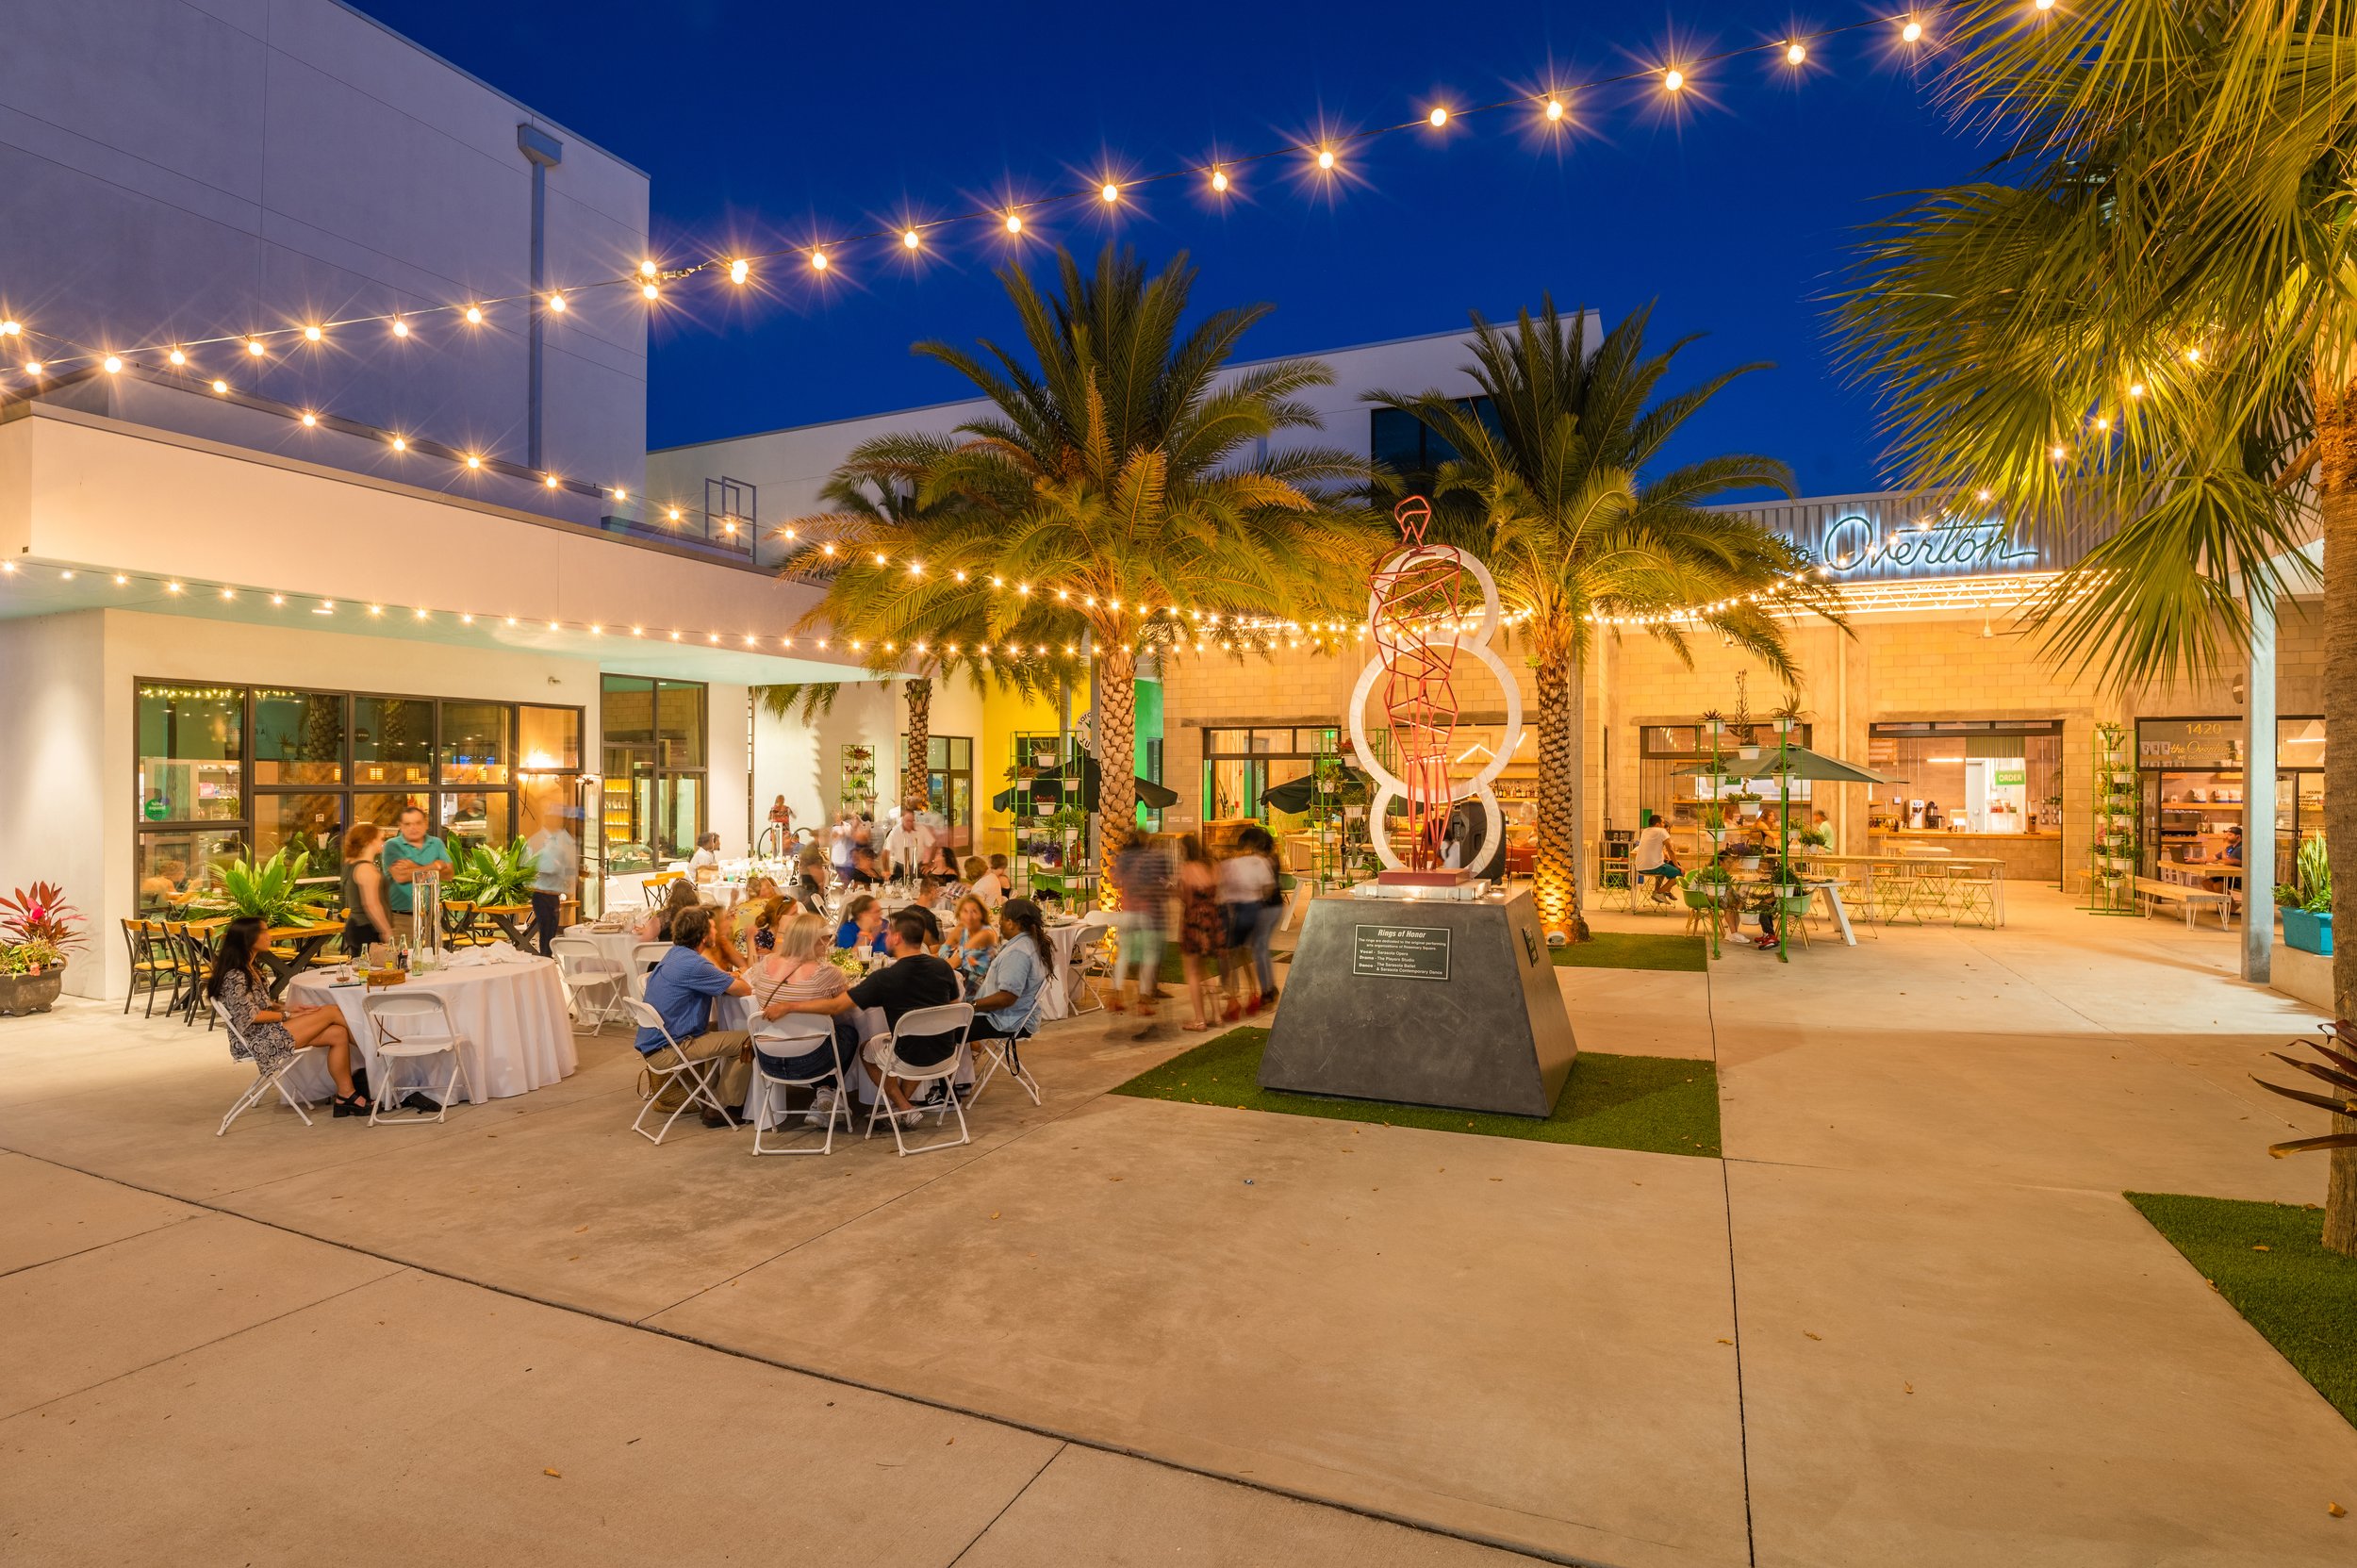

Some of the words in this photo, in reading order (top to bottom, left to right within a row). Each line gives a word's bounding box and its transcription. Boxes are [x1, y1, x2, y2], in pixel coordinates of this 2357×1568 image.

[1824, 514, 2038, 571] Overton
[2186, 723, 2221, 734] 1420
[2169, 743, 2185, 754] the
[2187, 740, 2237, 754] Overton
[1378, 929, 1396, 938] Rings
[1406, 930, 1426, 938] Honor
